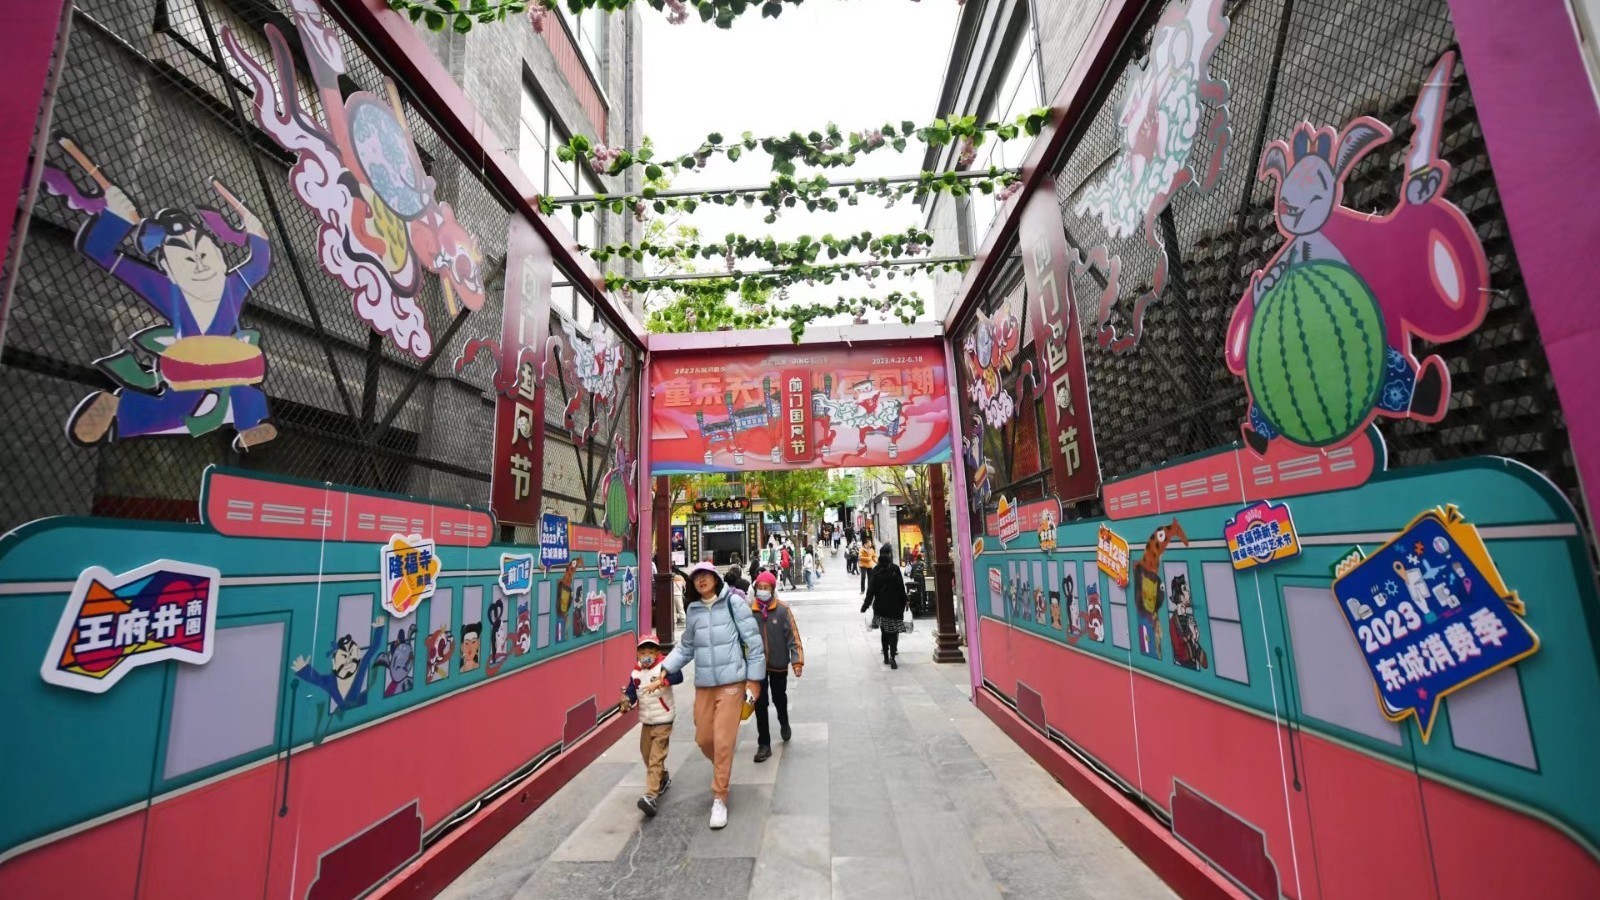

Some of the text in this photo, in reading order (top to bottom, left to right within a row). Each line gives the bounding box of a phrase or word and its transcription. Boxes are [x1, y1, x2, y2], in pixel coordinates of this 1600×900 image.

[872, 355, 923, 365] 2023.4.22-6.18
[789, 376, 806, 455] 前门国风节
[542, 532, 556, 544] 2023
[389, 548, 433, 580] 隆福寺
[73, 603, 184, 654] 王府井
[184, 599, 203, 636] 商圈
[1357, 600, 1422, 654] 2023
[1376, 606, 1509, 692] 东城消费季
